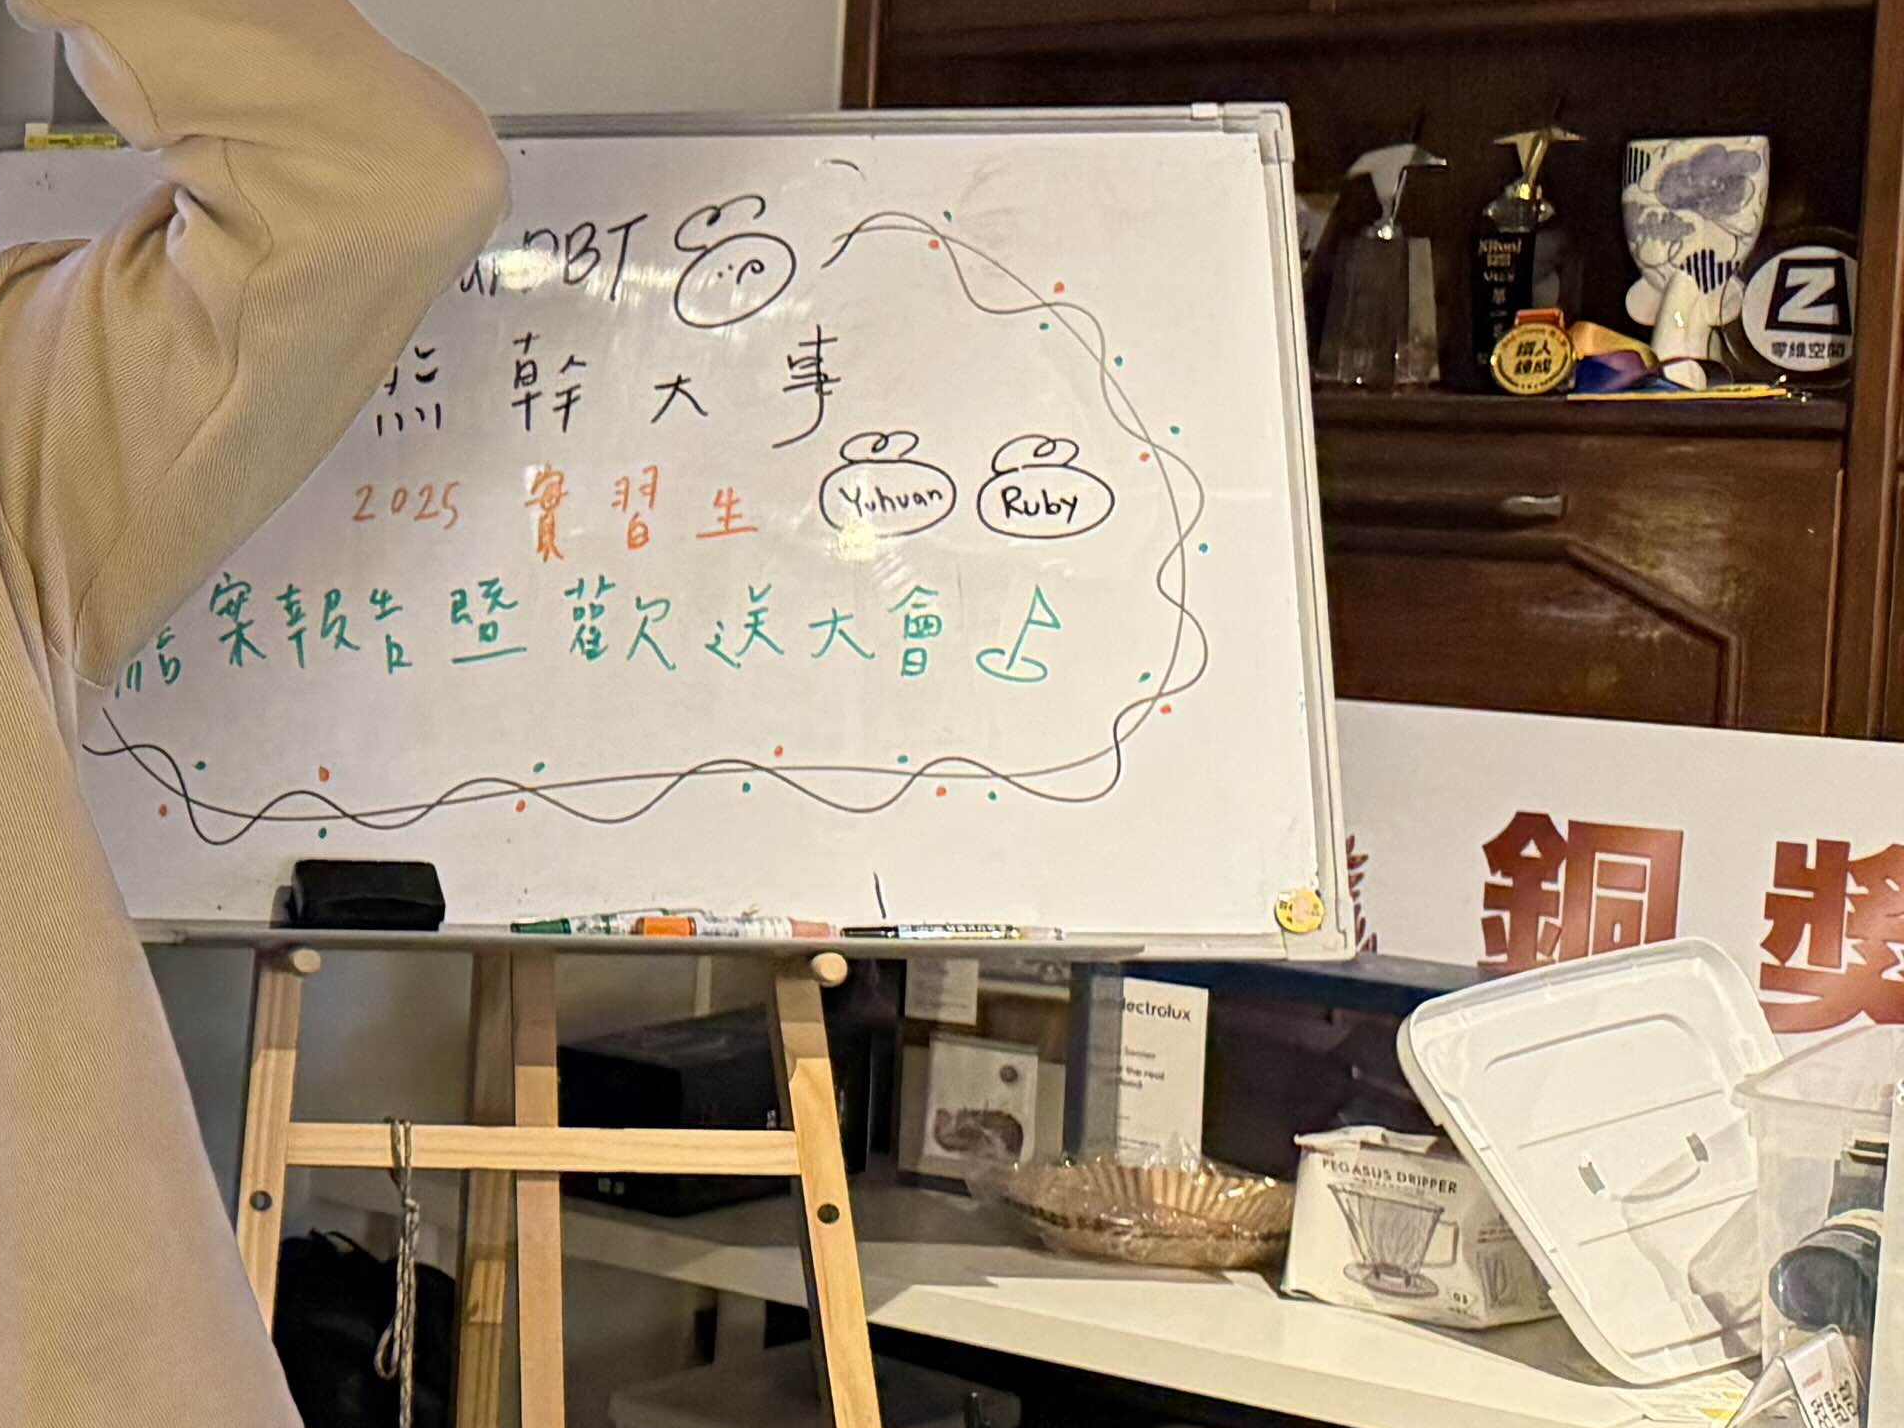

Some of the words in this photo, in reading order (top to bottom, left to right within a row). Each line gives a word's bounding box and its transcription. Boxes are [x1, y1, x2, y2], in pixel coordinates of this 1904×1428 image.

[352, 480, 461, 531] 2025
[838, 486, 944, 519] Yuhuan
[1000, 486, 1079, 525] Ruby
[1122, 997, 1192, 1022] lectrolux
[1321, 1158, 1393, 1183] PEGASUS
[1396, 1170, 1458, 1195] DRIPPER
